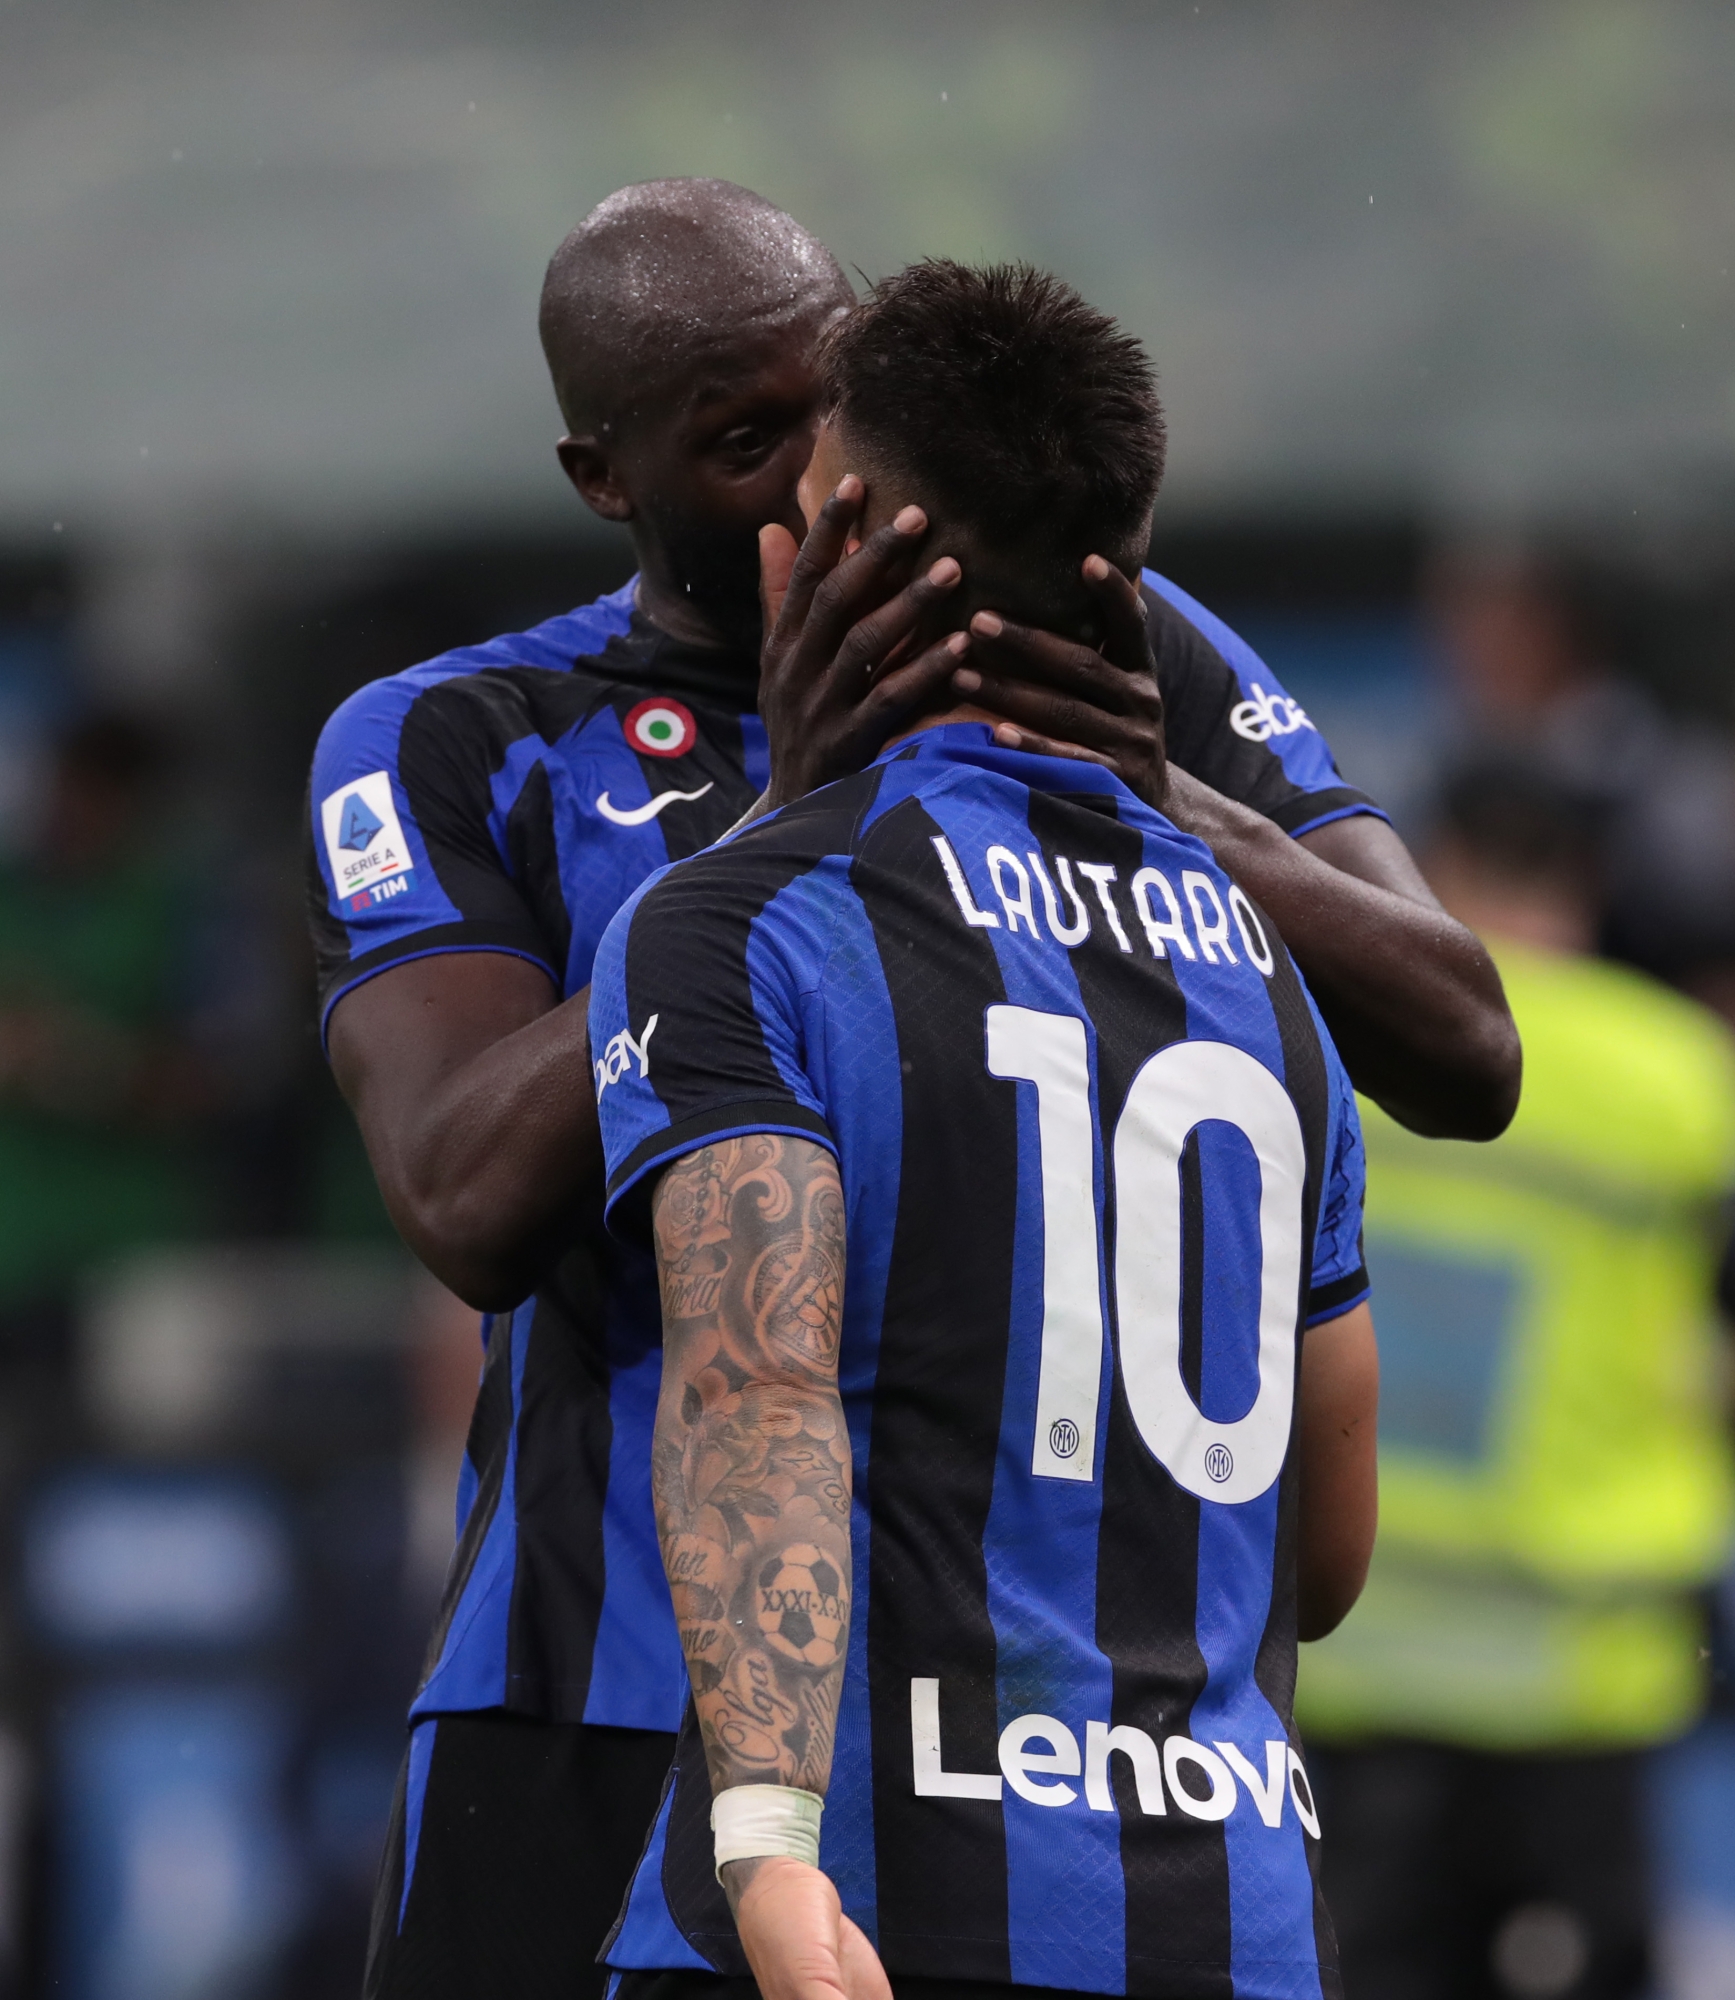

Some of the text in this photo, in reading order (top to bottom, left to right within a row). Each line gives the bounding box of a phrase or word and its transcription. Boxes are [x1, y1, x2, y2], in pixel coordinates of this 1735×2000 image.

[343, 848, 396, 881] SERIE A
[369, 874, 408, 903] TIM
[930, 834, 1275, 979] LAUTARO
[984, 1003, 1306, 1505] 10
[663, 1534, 708, 1577] lan
[715, 1657, 796, 1763] Olga
[910, 1677, 1322, 1841] Lenovo
